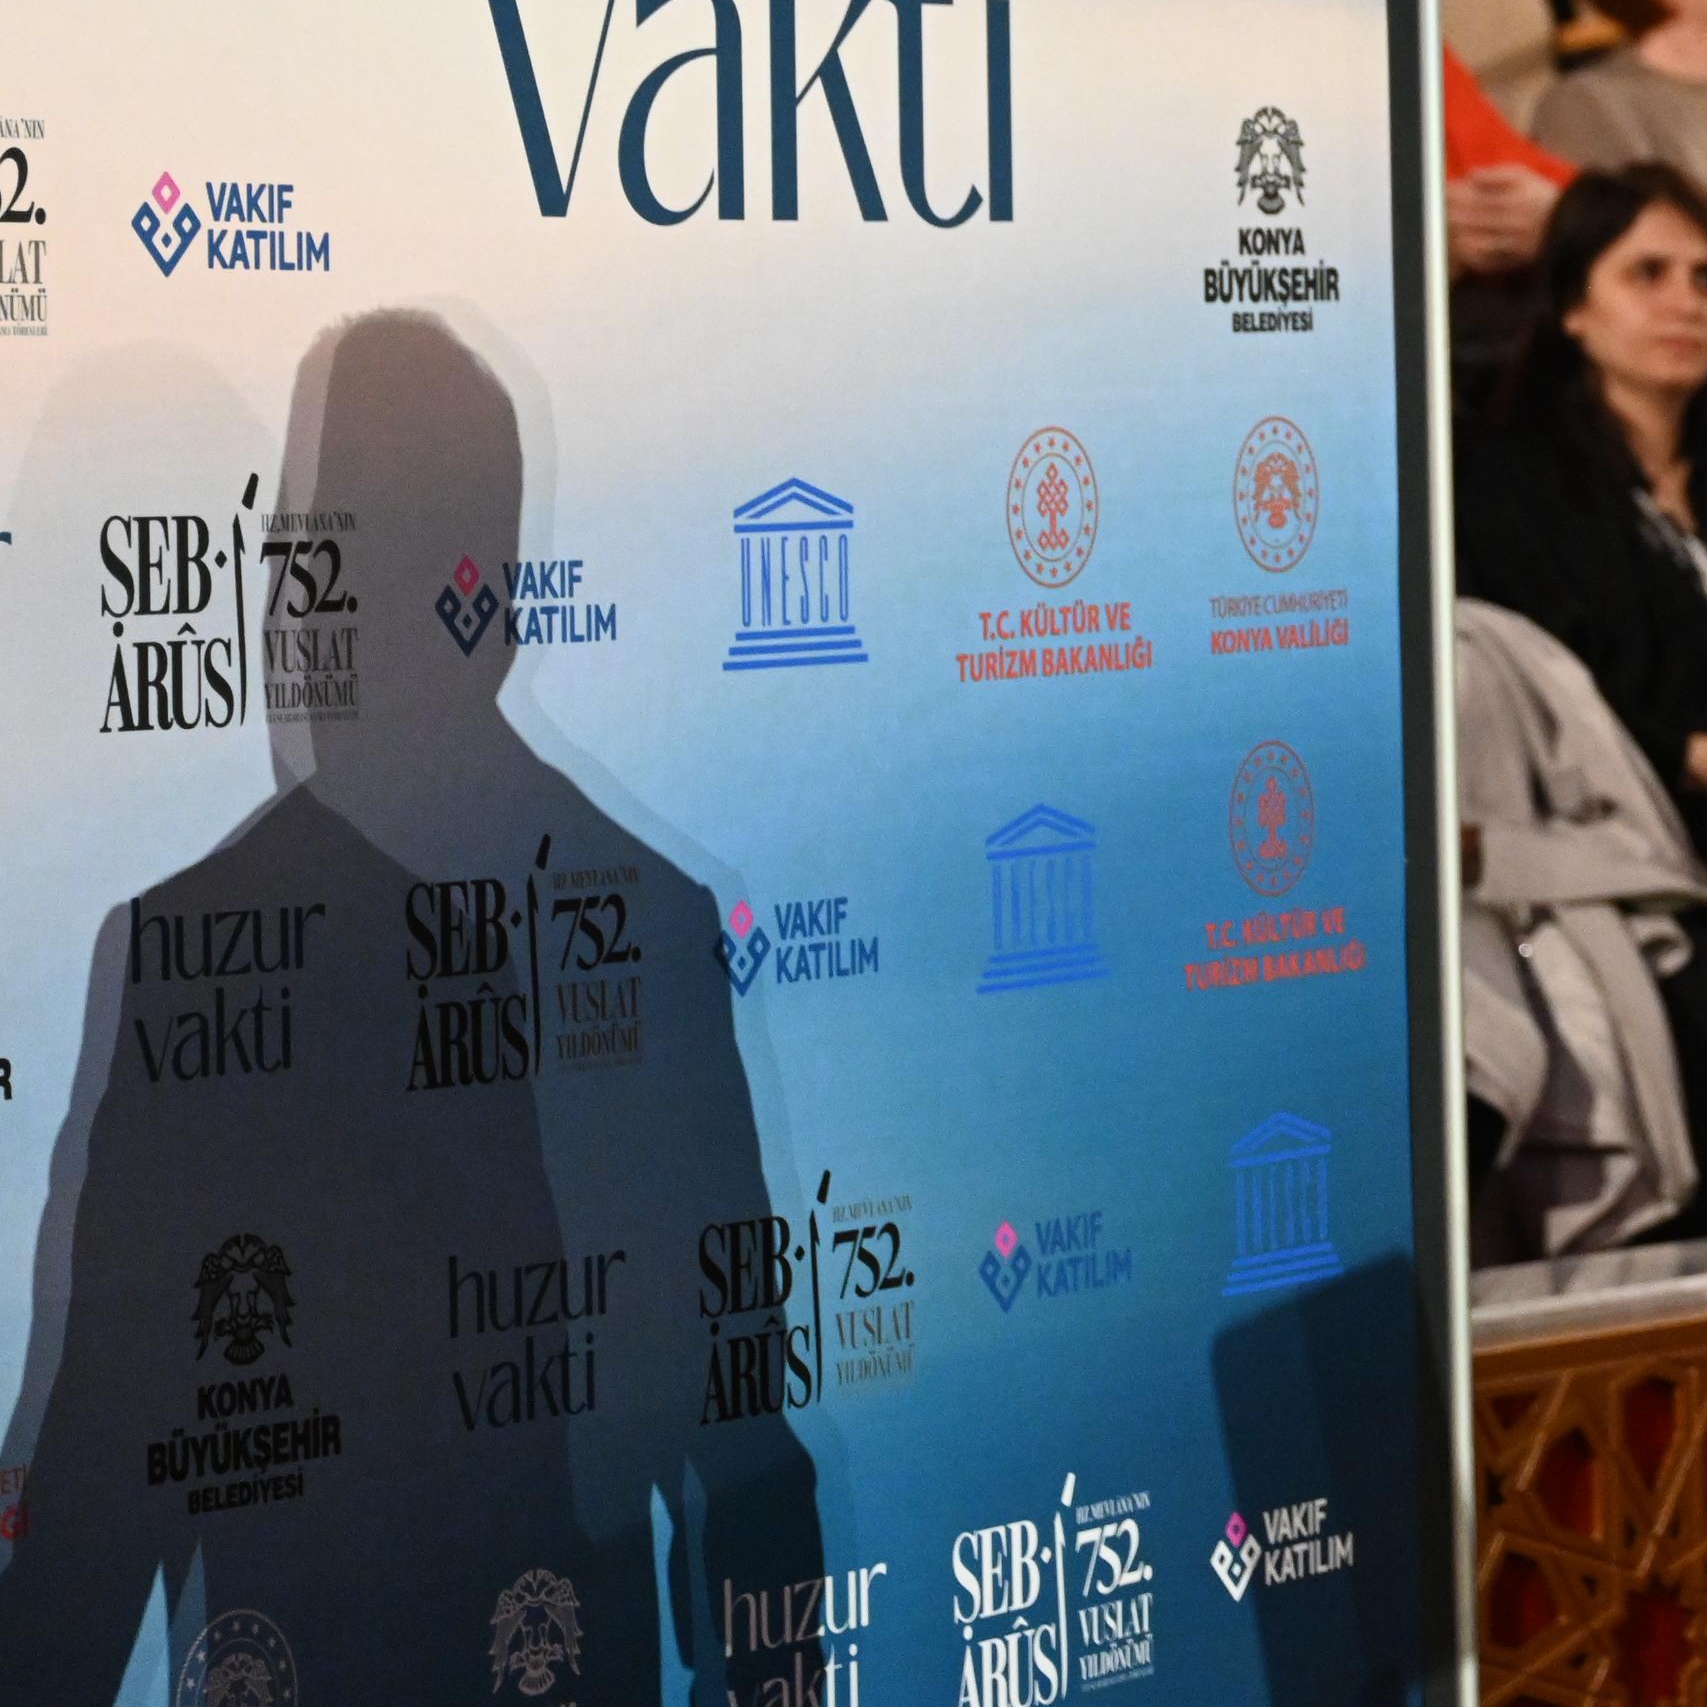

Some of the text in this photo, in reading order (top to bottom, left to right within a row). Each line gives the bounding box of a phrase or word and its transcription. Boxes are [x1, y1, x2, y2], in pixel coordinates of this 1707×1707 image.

[206, 181, 293, 224] VAKIF
[207, 229, 330, 272] KATILIM
[1238, 227, 1305, 257] KONYA
[1204, 264, 1340, 308] BÜYÜKŞEHİR
[1232, 304, 1314, 333] BELEDİYESİ
[259, 539, 358, 619] 752.
[503, 559, 584, 599] VAKIF
[741, 534, 849, 627] UNESCO
[504, 603, 617, 646] KATILIM
[979, 601, 1130, 641] T.C. KÜLTÜR VE
[1211, 627, 1273, 654] KONYA
[263, 627, 358, 673] VUSLAT
[956, 640, 1153, 683] TURİZM BAKANLIĞI
[99, 623, 234, 733] ARÛS
[129, 896, 326, 984] huzur
[552, 894, 642, 972] 752.
[775, 897, 847, 941] VAKIF
[776, 937, 878, 985] KATILIM
[135, 985, 292, 1083] vakti
[405, 982, 529, 1092] ARÛS
[1034, 1210, 1101, 1253] VAKIF
[832, 1222, 914, 1299] 752.
[1036, 1249, 1131, 1298] KATILIM
[447, 1250, 626, 1338] huzur
[836, 1300, 915, 1350] VUSLAT
[453, 1330, 596, 1432] vakti
[700, 1315, 812, 1428] ARÛS
[198, 1374, 293, 1421] KONYA
[146, 1409, 341, 1486] BÜYÜKŞEHİR
[1264, 1497, 1328, 1545] VAKIF
[1075, 1518, 1153, 1597] 752.
[1265, 1532, 1353, 1585] KATILIM
[724, 1563, 887, 1658] huzur
[1078, 1593, 1153, 1647] VUSLAT
[727, 1643, 858, 1707] akti
[958, 1616, 1058, 1707] ARÛS
